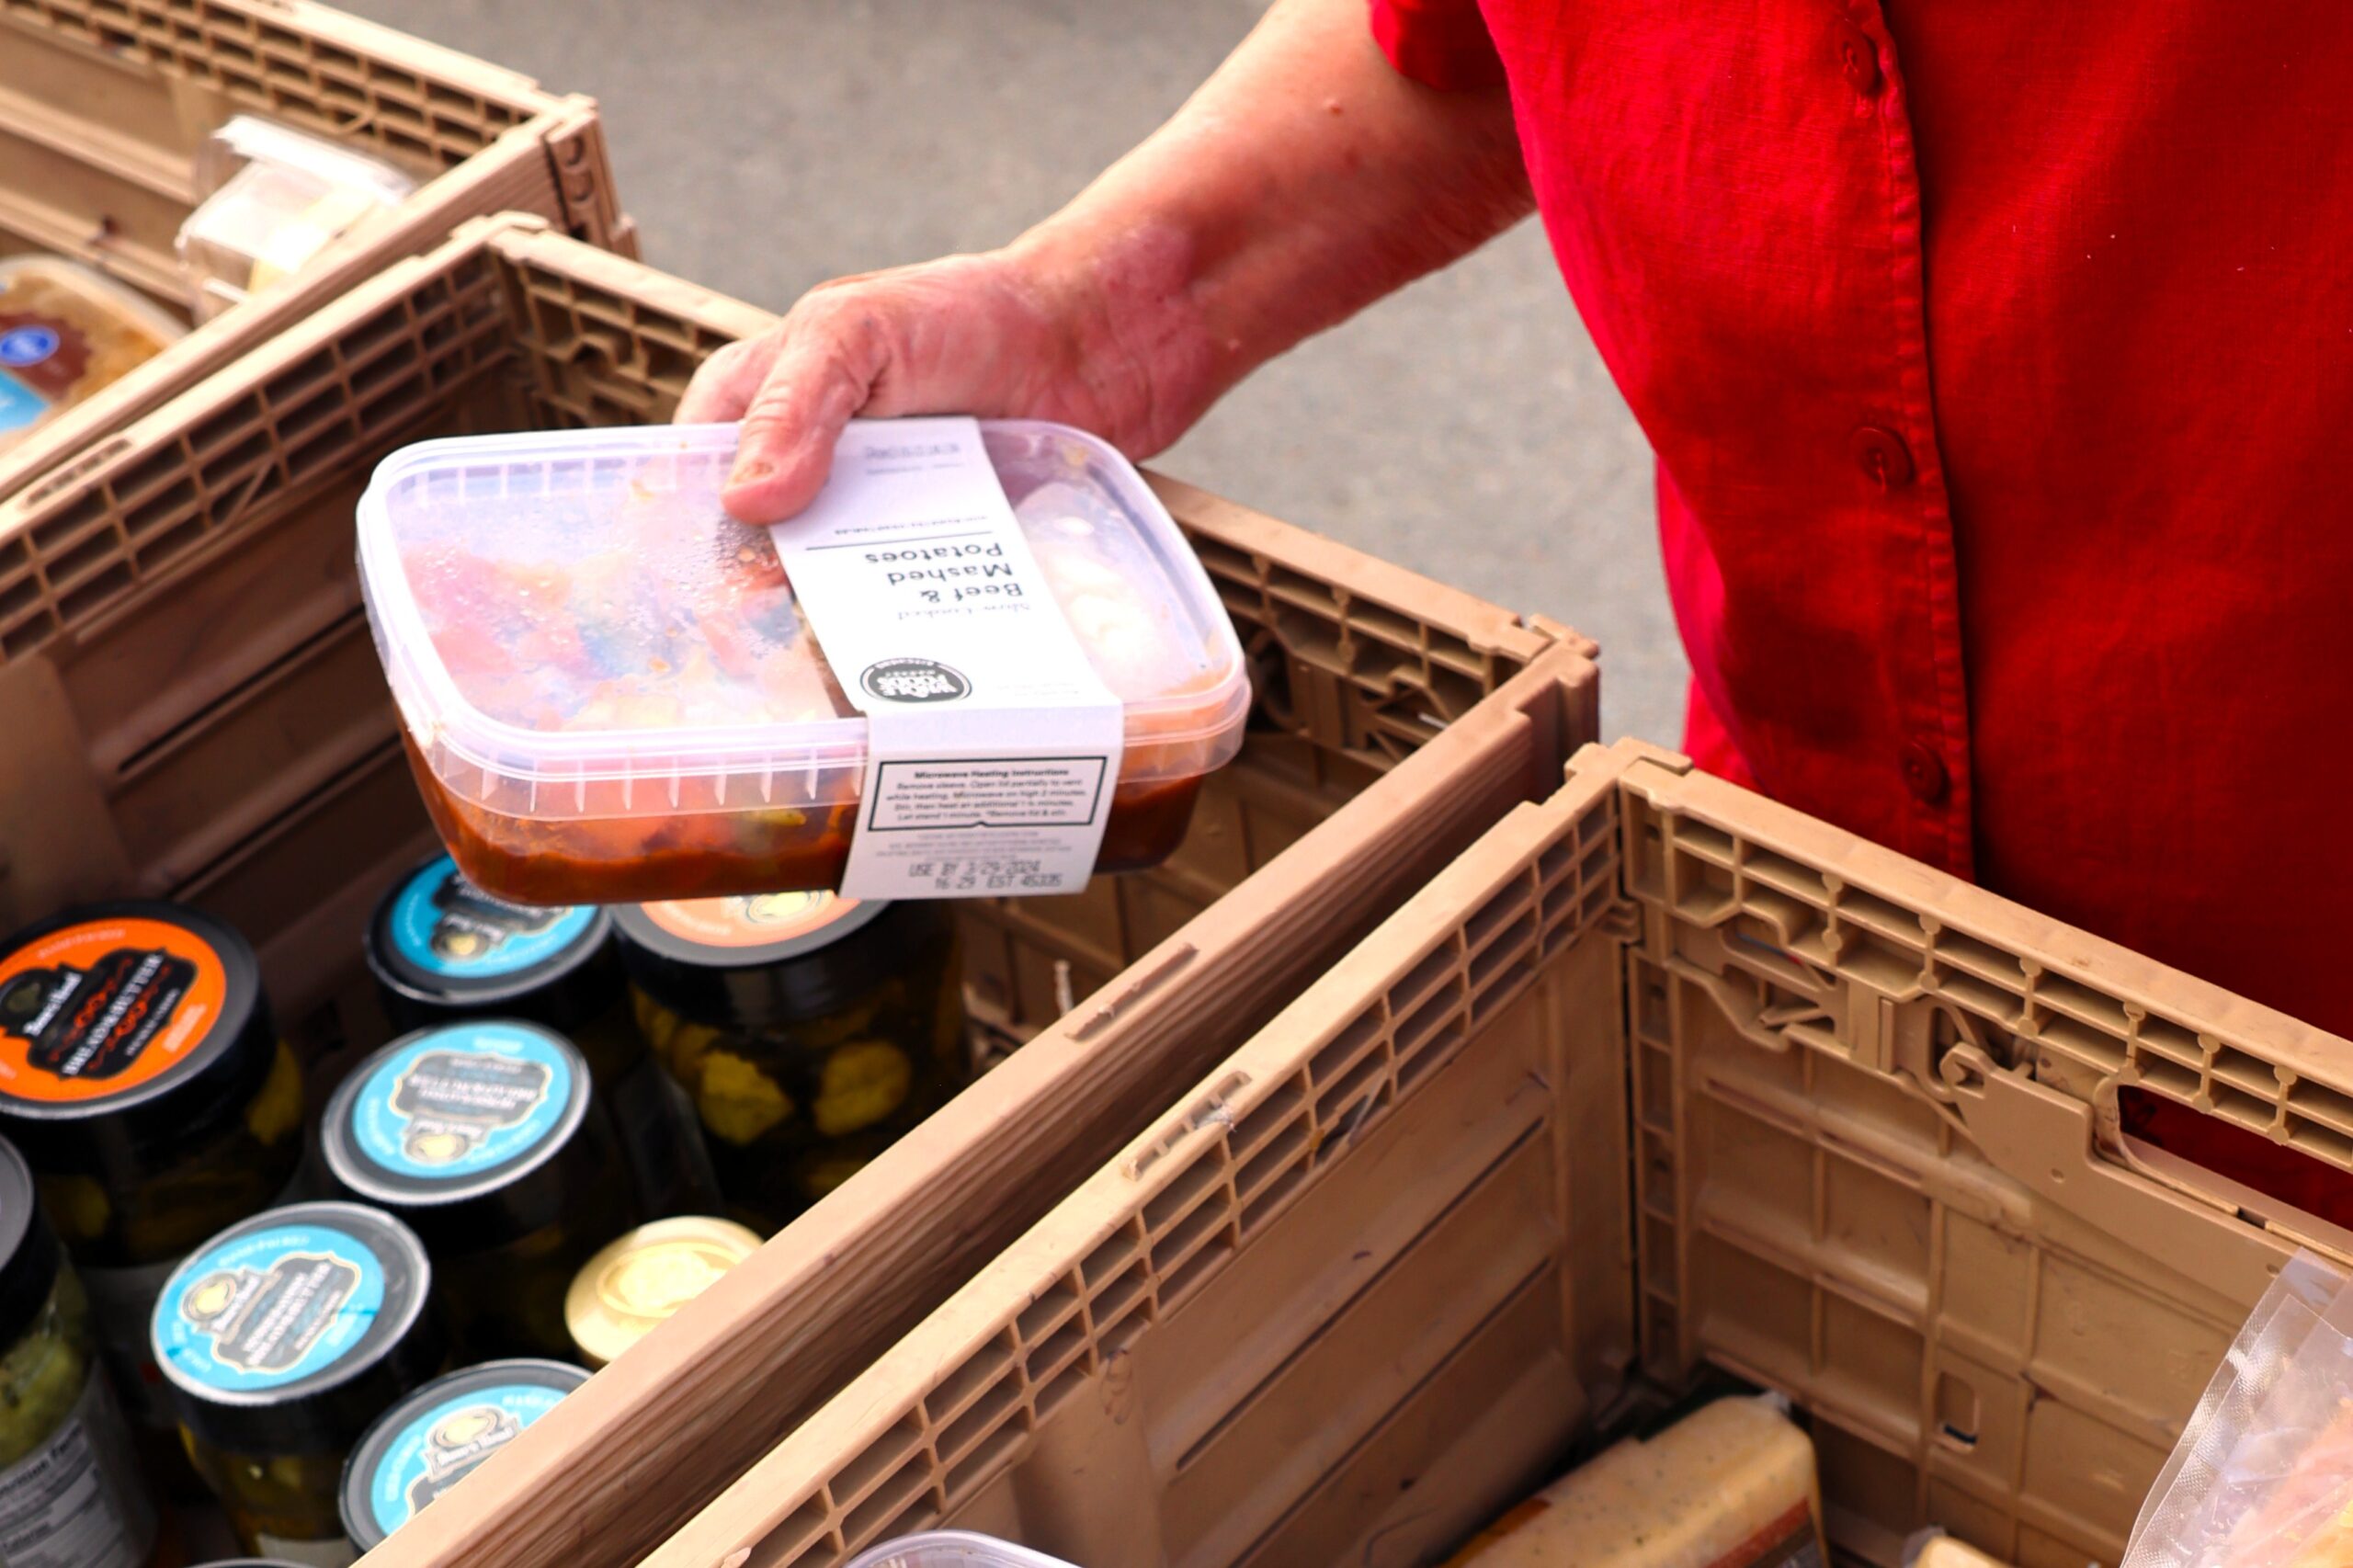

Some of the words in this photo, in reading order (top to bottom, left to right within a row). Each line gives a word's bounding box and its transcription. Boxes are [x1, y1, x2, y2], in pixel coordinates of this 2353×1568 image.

[864, 541, 1005, 563] Potatoes
[886, 562, 1014, 586] Mashed
[920, 590, 941, 603] &
[954, 583, 1024, 602] Beef
[914, 770, 968, 778] Microwave
[972, 769, 1008, 778] Heating
[1012, 768, 1069, 777] Instructions
[908, 862, 934, 877] USE
[941, 861, 958, 876] BY
